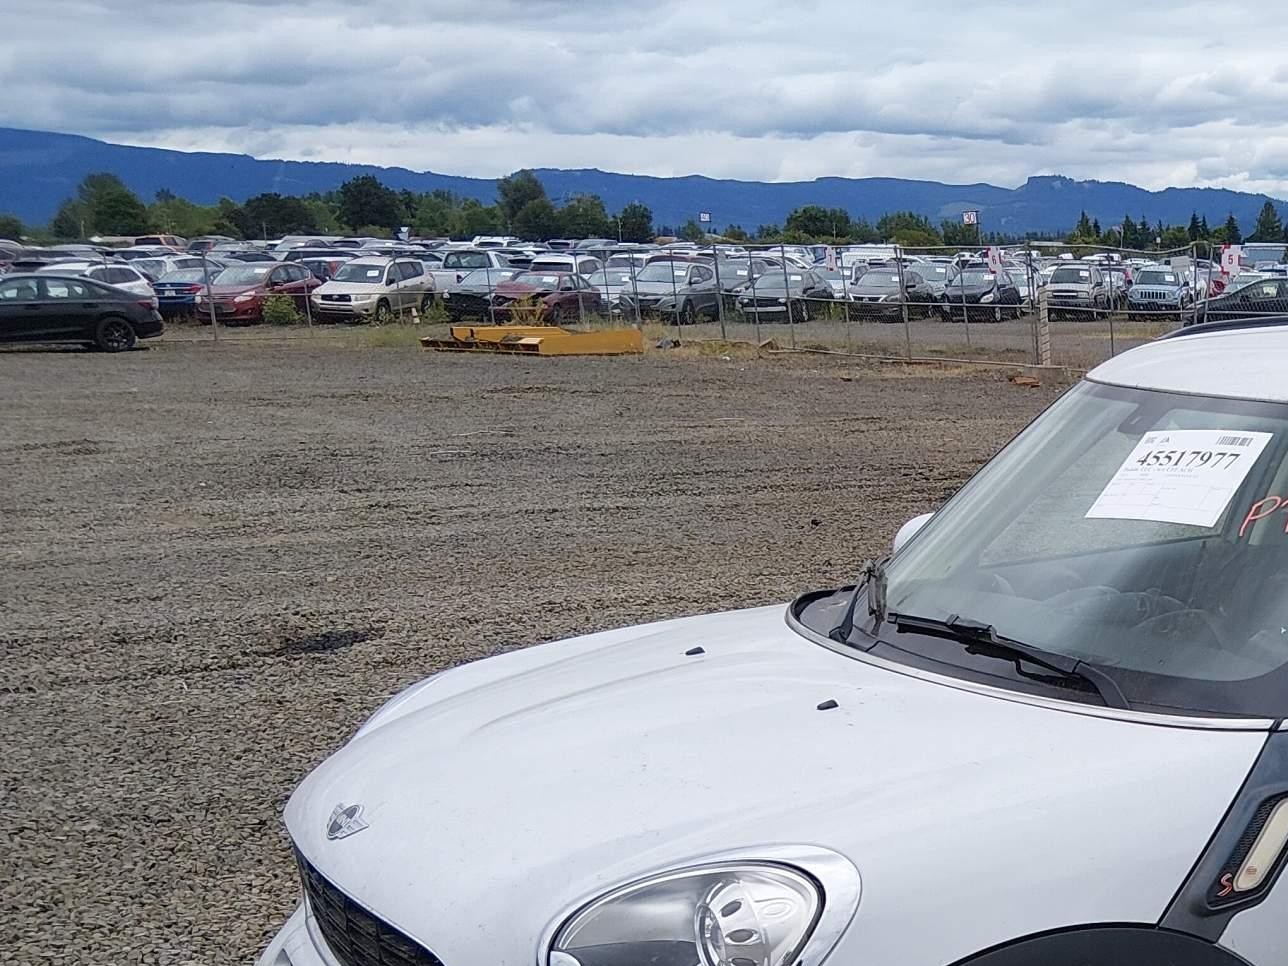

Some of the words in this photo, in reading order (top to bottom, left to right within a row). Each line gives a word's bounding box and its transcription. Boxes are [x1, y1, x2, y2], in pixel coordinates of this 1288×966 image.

[964, 212, 976, 223] 30
[991, 255, 997, 265] 6
[1227, 254, 1234, 265] 5
[1136, 450, 1241, 470] 45517977
